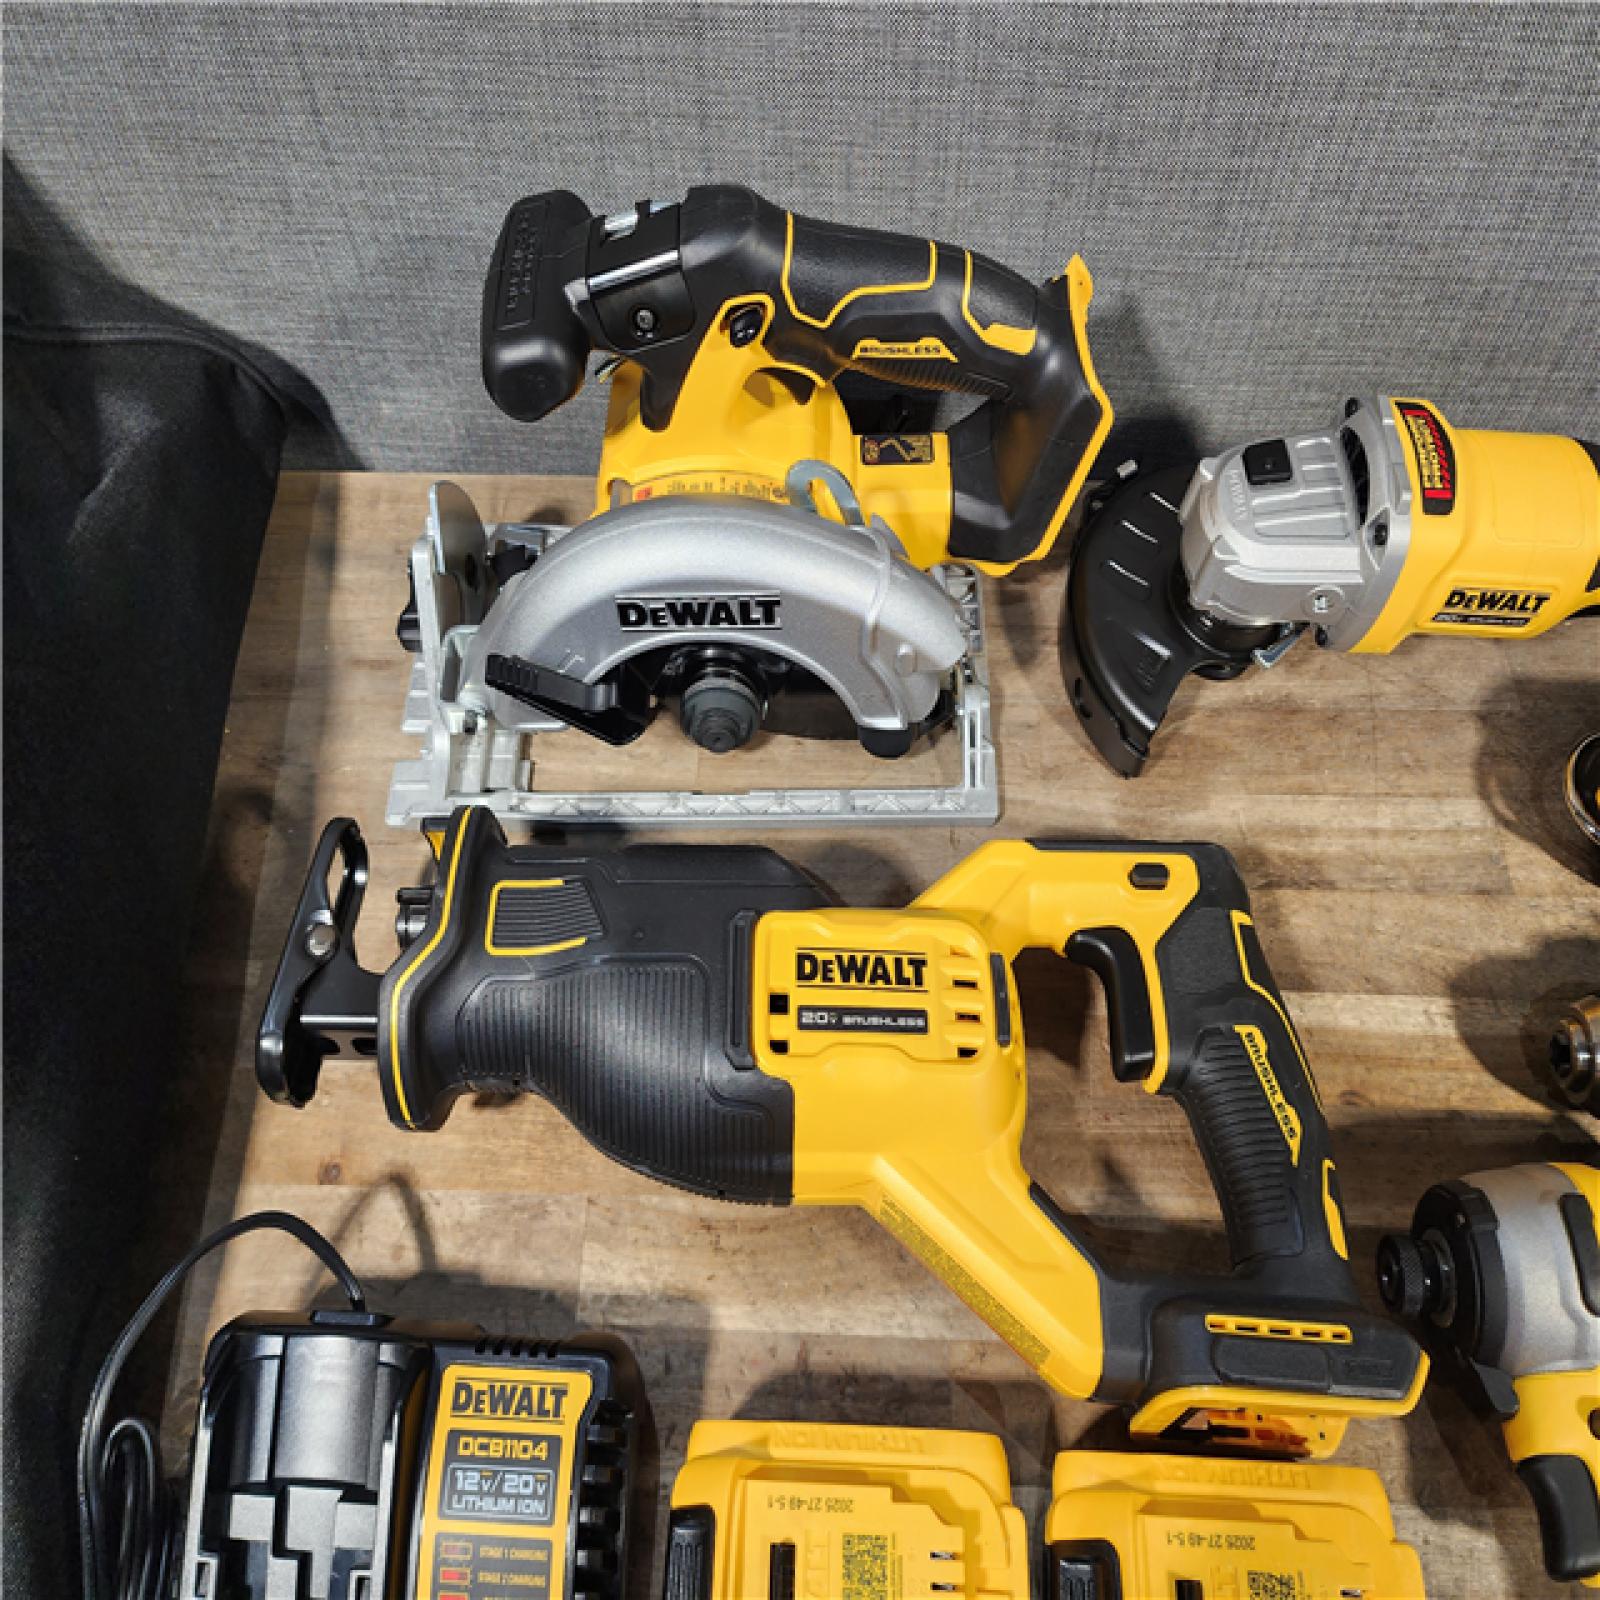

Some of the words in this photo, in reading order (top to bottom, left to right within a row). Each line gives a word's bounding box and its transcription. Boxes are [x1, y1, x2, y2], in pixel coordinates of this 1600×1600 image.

[859, 345, 941, 356] BRUSHLESS
[616, 599, 781, 626] DEWALT
[1444, 589, 1551, 613] DEWALT
[796, 953, 929, 987] DEWALT
[842, 1014, 926, 1028] BRUSHLESS
[1244, 1030, 1298, 1140] BRUSHLESS
[452, 1382, 569, 1419] DEWALT
[458, 1436, 549, 1461] DCB1104
[452, 1494, 516, 1513] LITHIUM
[518, 1499, 547, 1516] ION
